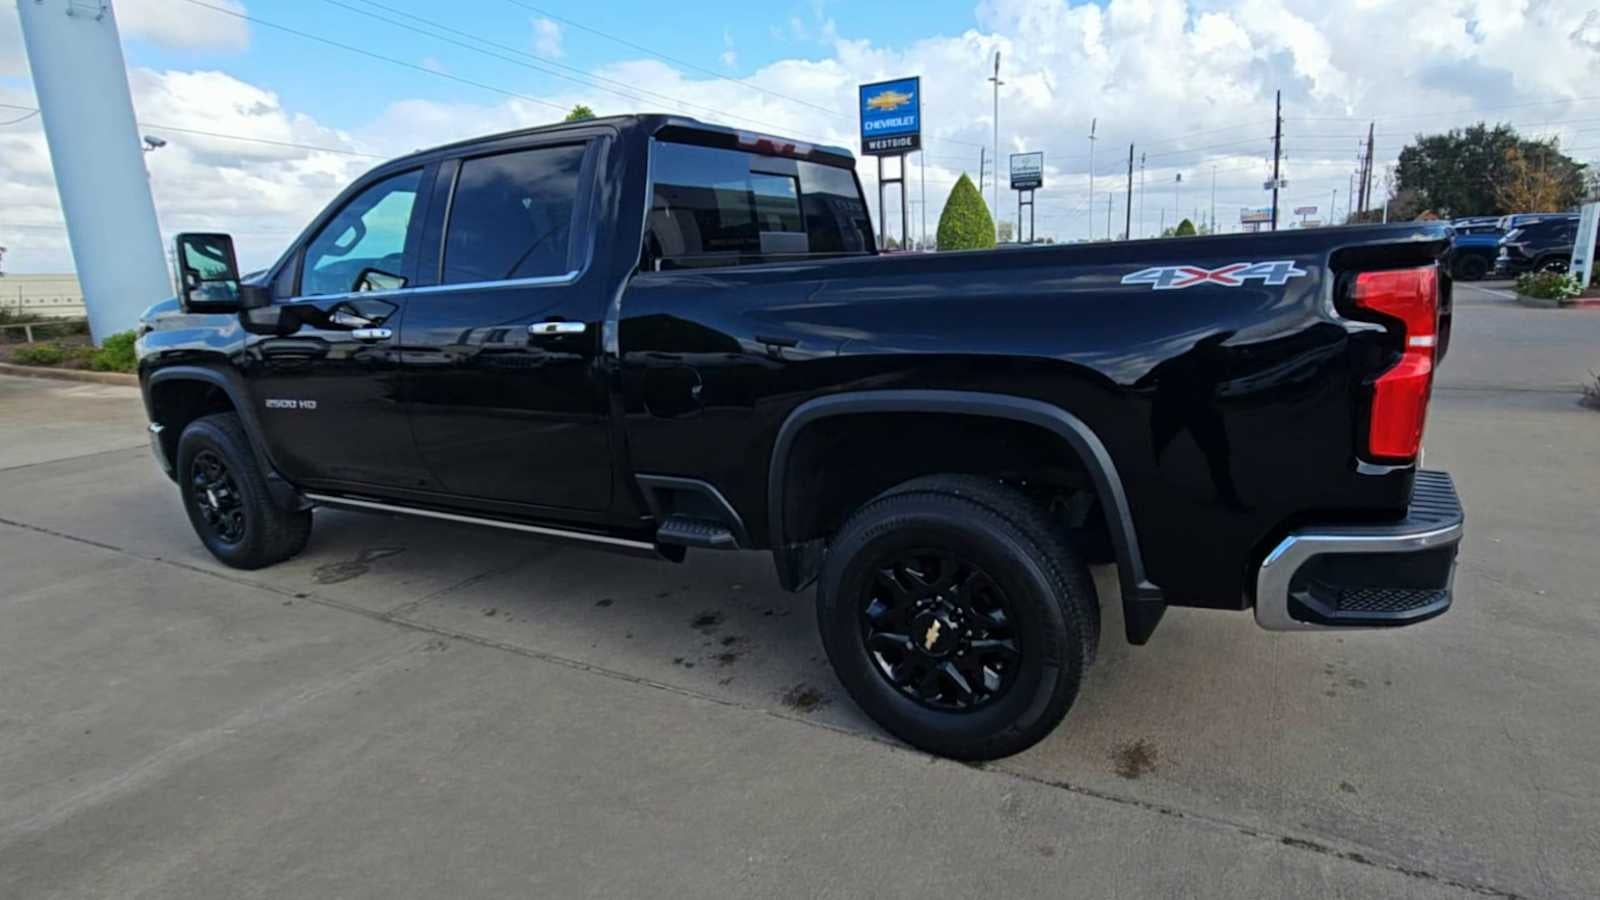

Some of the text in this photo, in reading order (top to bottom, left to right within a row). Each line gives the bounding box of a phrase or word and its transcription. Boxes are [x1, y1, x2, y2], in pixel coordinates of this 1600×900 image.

[864, 116, 914, 130] CHEVROLET
[868, 137, 912, 149] WESTSIDE
[265, 399, 317, 409] 2500 HD
